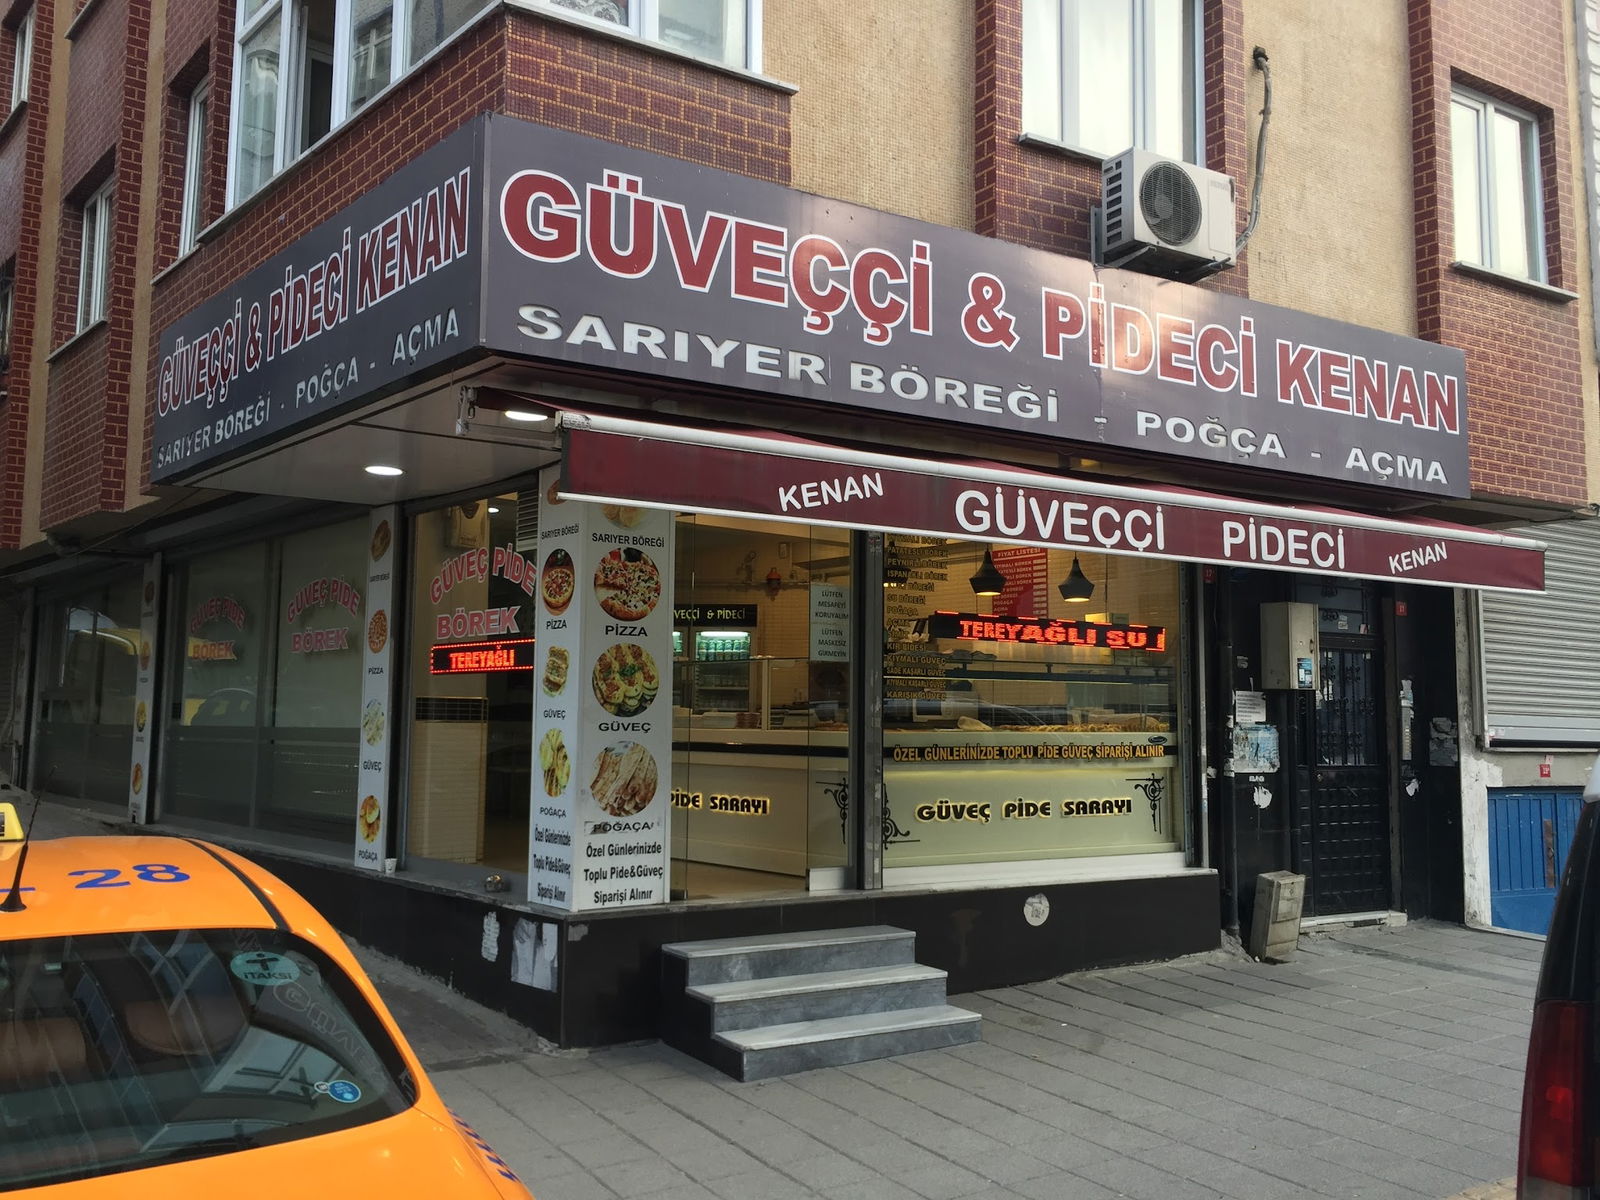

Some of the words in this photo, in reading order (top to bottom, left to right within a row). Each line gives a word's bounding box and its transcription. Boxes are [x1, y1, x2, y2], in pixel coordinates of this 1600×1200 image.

[156, 297, 242, 416] GÜVEÇÇİ
[244, 302, 263, 373] &
[267, 226, 351, 362] PİDECİ
[356, 166, 470, 313] KENAN
[500, 169, 932, 346] GÜVEÇÇİ
[961, 272, 1020, 352] &
[1041, 282, 1257, 398] PİDECİ
[1277, 338, 1459, 435] KENAN
[157, 427, 211, 468] SARIYER
[214, 391, 271, 444] BÖREĞİ
[295, 357, 359, 408] POĞÇA
[392, 308, 459, 366] AÇMA
[517, 304, 828, 386] SARIYER
[850, 364, 1058, 423] BÖREĞİ
[1137, 409, 1287, 459] POĞÇA
[1346, 447, 1448, 485] AÇMA
[778, 472, 884, 512] KENAN
[955, 486, 1165, 552] GÜVEÇÇİ
[1222, 517, 1345, 570] PİDECİ
[1389, 541, 1448, 575] KENAN
[592, 532, 631, 546] SARIYER
[632, 535, 665, 548] BÖREĞİ
[430, 547, 489, 604] GÜVEÇ
[492, 543, 537, 596] PİDE
[436, 606, 521, 640] BÖREK
[546, 619, 567, 630] PİZZA
[605, 623, 648, 637] PİZZA
[960, 619, 1096, 645] TEREYAĞLI
[1106, 629, 1147, 648] SU
[291, 627, 349, 654] BÖREK
[449, 645, 515, 669] TEREYAĞLI
[368, 666, 384, 675] PİZZA
[543, 709, 566, 720] GÜVEÇ
[598, 721, 651, 733] GÜVEÇ
[893, 746, 921, 762] ÖZEL
[924, 743, 1000, 761] GÜNLERİNİZDE
[1002, 745, 1034, 759] TOPLU
[1037, 742, 1060, 758] PİDE
[1061, 743, 1094, 760] GÜVEÇ
[1095, 742, 1133, 760] SİPARİŞİ
[1135, 745, 1164, 758] ALINIR
[540, 806, 566, 819] POĞAÇA
[709, 795, 768, 814] SARAYI
[916, 800, 991, 823] GÜVEÇ
[1004, 798, 1050, 818] PİDE
[1063, 799, 1132, 816] SARAYI
[586, 842, 605, 858] Özel
[608, 841, 662, 857] Günlerinizde
[68, 863, 190, 890] 28
[584, 868, 607, 884] Toplu
[610, 865, 663, 881] Pide&Güveç
[594, 888, 627, 906] Siparişi
[629, 889, 653, 901] Alınır
